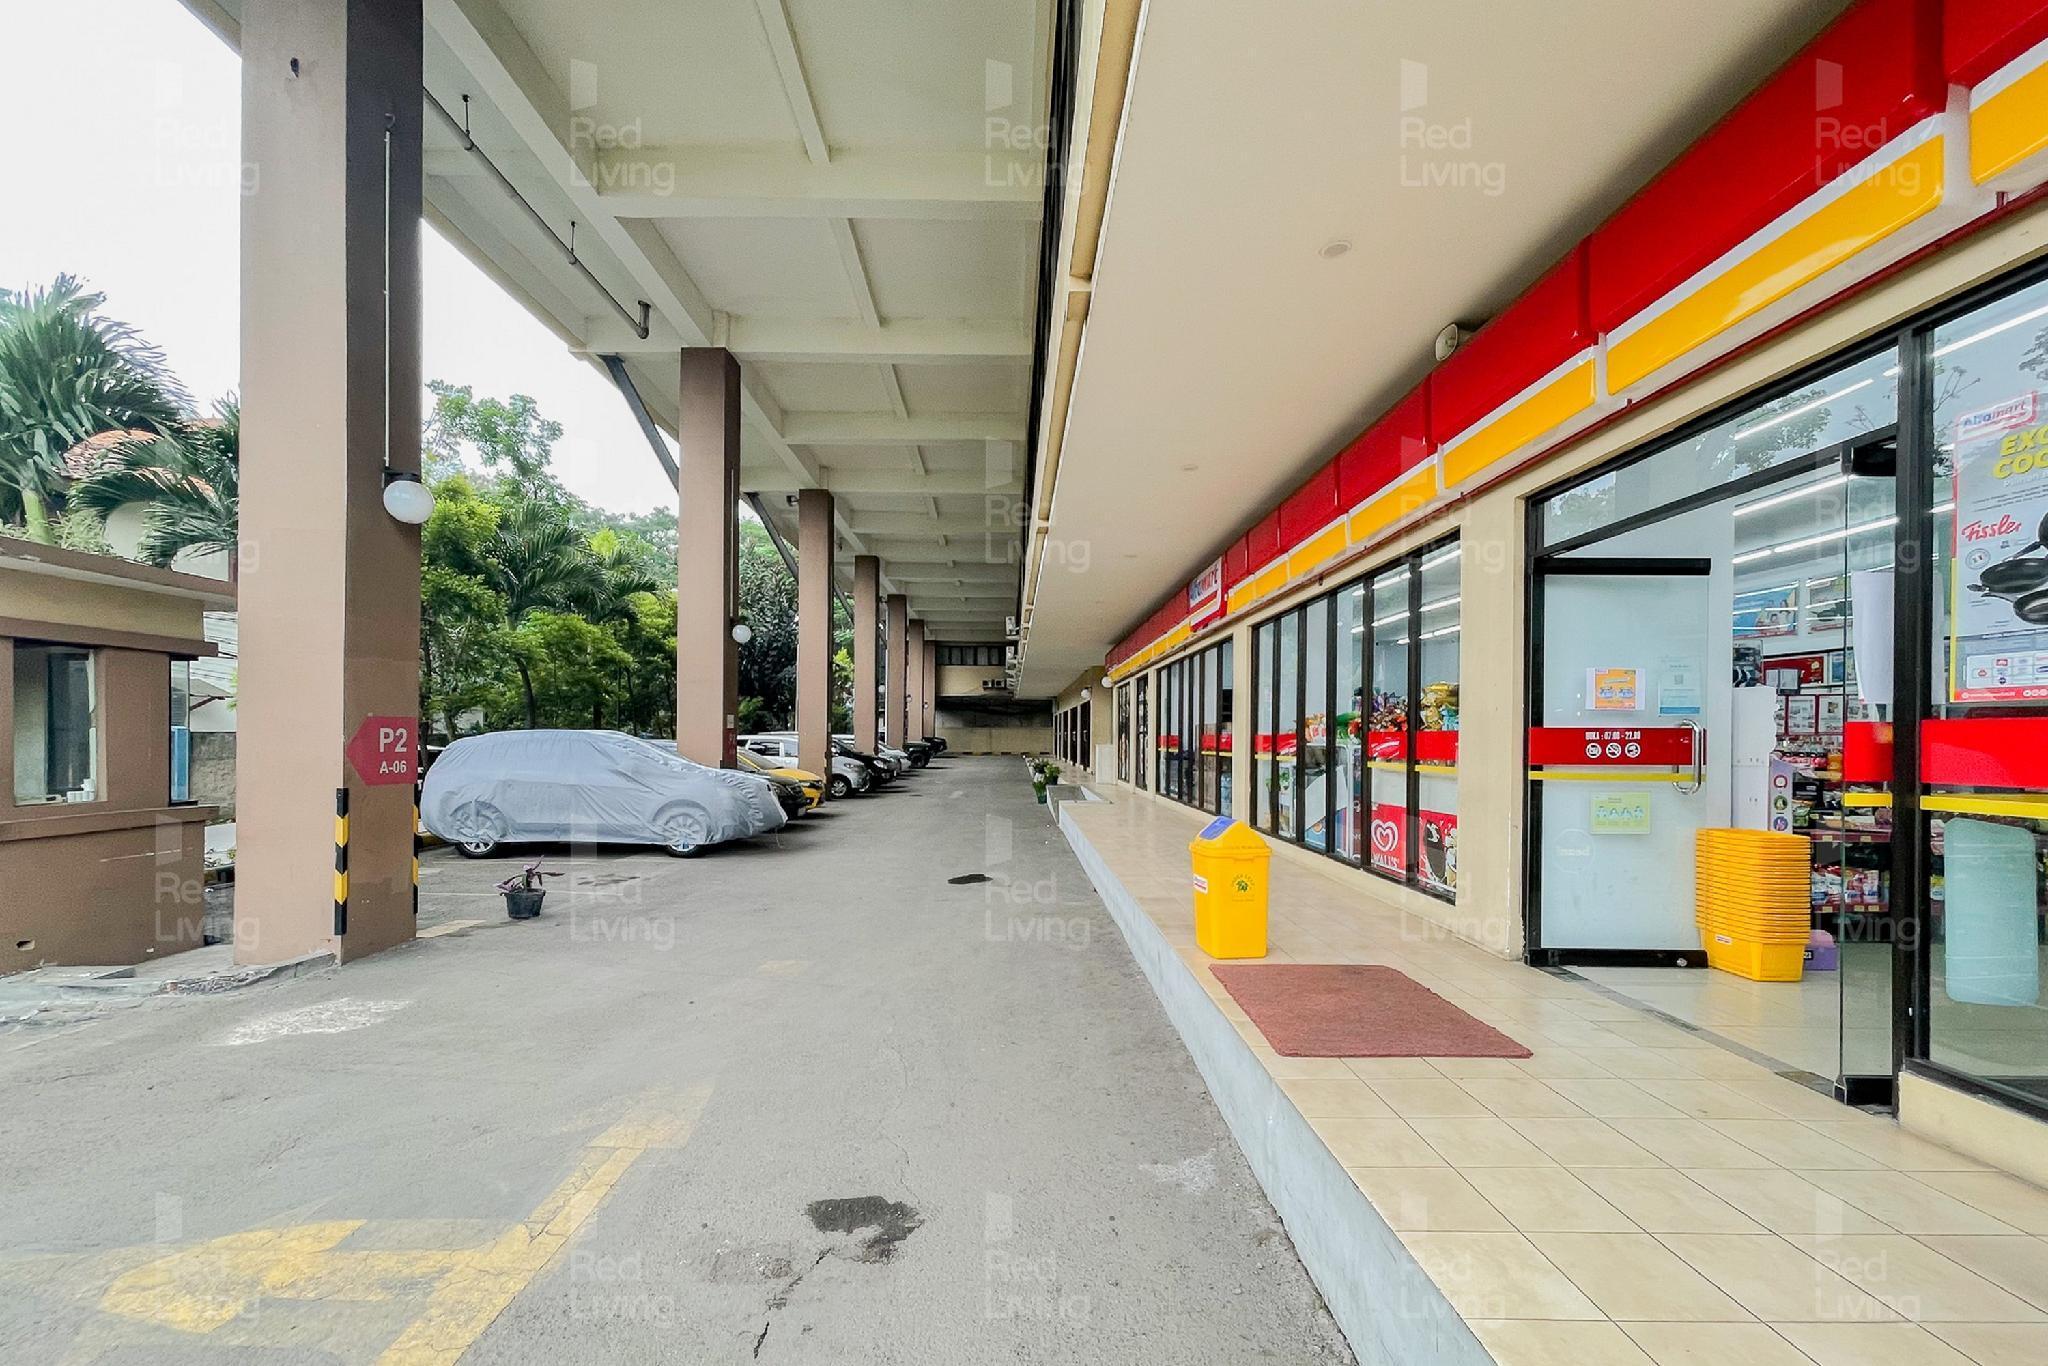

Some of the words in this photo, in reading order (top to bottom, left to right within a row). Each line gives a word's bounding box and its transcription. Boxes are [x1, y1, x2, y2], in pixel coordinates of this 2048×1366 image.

[1961, 513, 2022, 542] Fissler
[379, 727, 408, 753] P2
[379, 760, 407, 774] A-06
